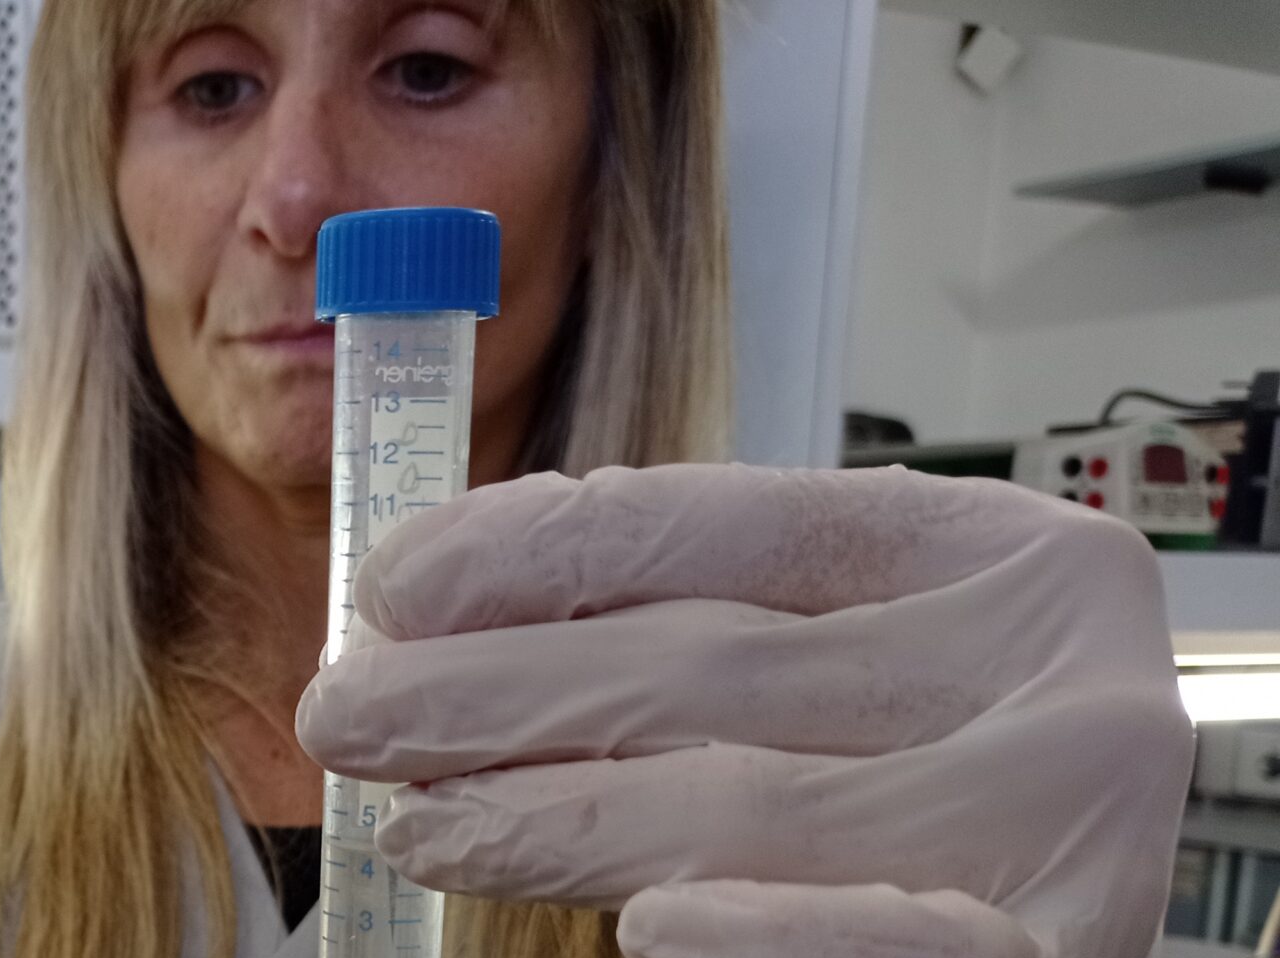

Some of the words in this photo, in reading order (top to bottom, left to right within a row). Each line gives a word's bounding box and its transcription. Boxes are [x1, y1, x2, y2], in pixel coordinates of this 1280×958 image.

[373, 340, 401, 360] 14
[371, 391, 401, 413] 13
[369, 442, 398, 464] 12
[369, 493, 396, 516] 11
[361, 805, 376, 827] 5
[360, 859, 375, 879] 4
[358, 910, 373, 931] 3
